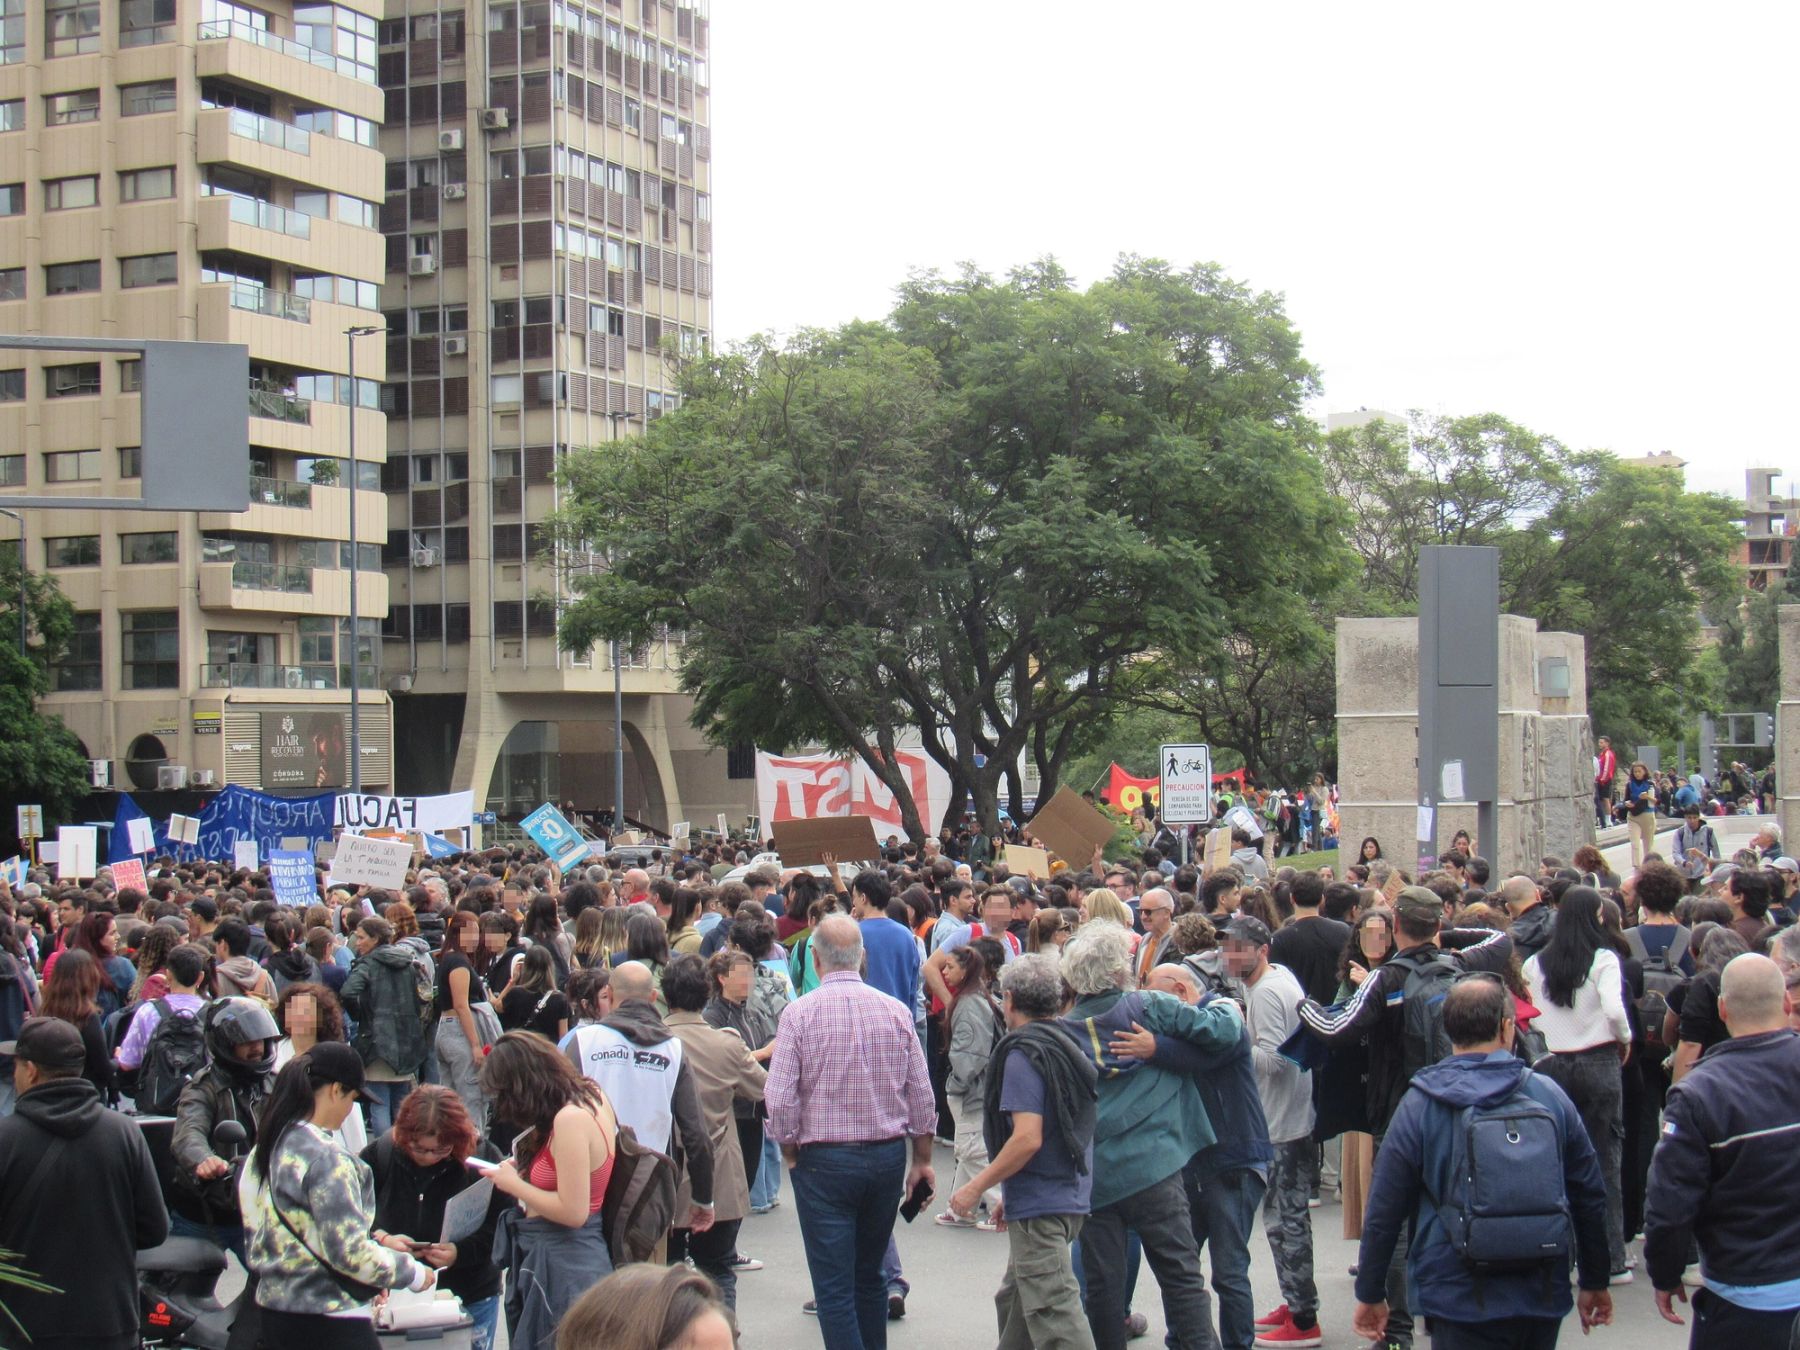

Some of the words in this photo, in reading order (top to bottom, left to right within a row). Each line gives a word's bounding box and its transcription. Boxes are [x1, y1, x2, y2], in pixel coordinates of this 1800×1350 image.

[276, 735, 299, 746] HAIR
[271, 746, 304, 755] RECOVERY
[1165, 783, 1205, 792] PRECAUCION
[524, 806, 554, 832] DIRECTV
[590, 1048, 629, 1062] conadu
